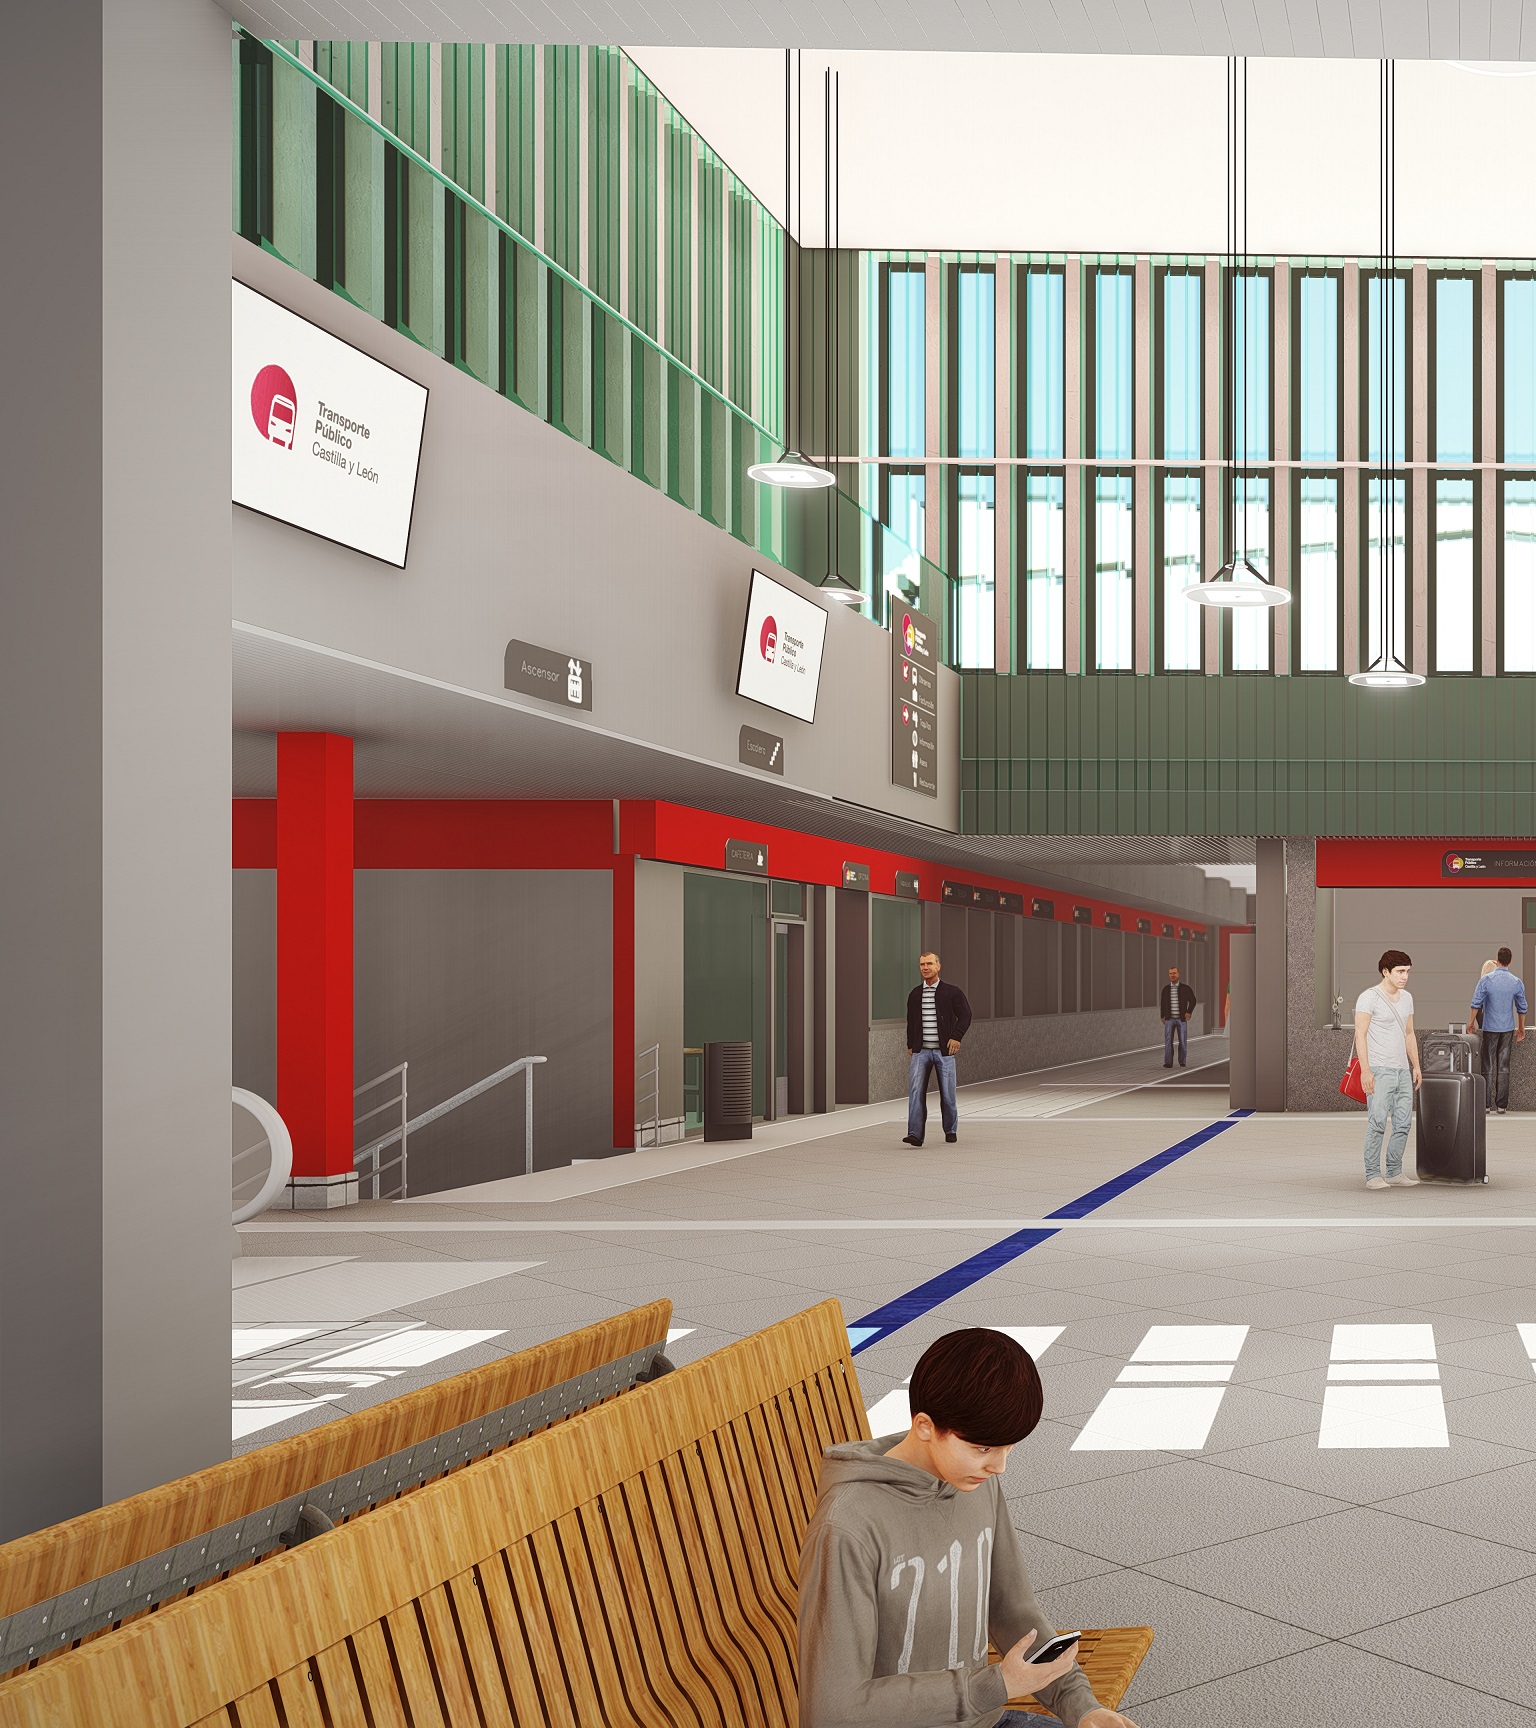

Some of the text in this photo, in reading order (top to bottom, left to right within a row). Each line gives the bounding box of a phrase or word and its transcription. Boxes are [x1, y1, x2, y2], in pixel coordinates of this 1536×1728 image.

[314, 420, 352, 450] Público
[318, 400, 370, 439] Transporte
[312, 441, 379, 484] Castilla y León
[521, 660, 560, 682] Ascensor
